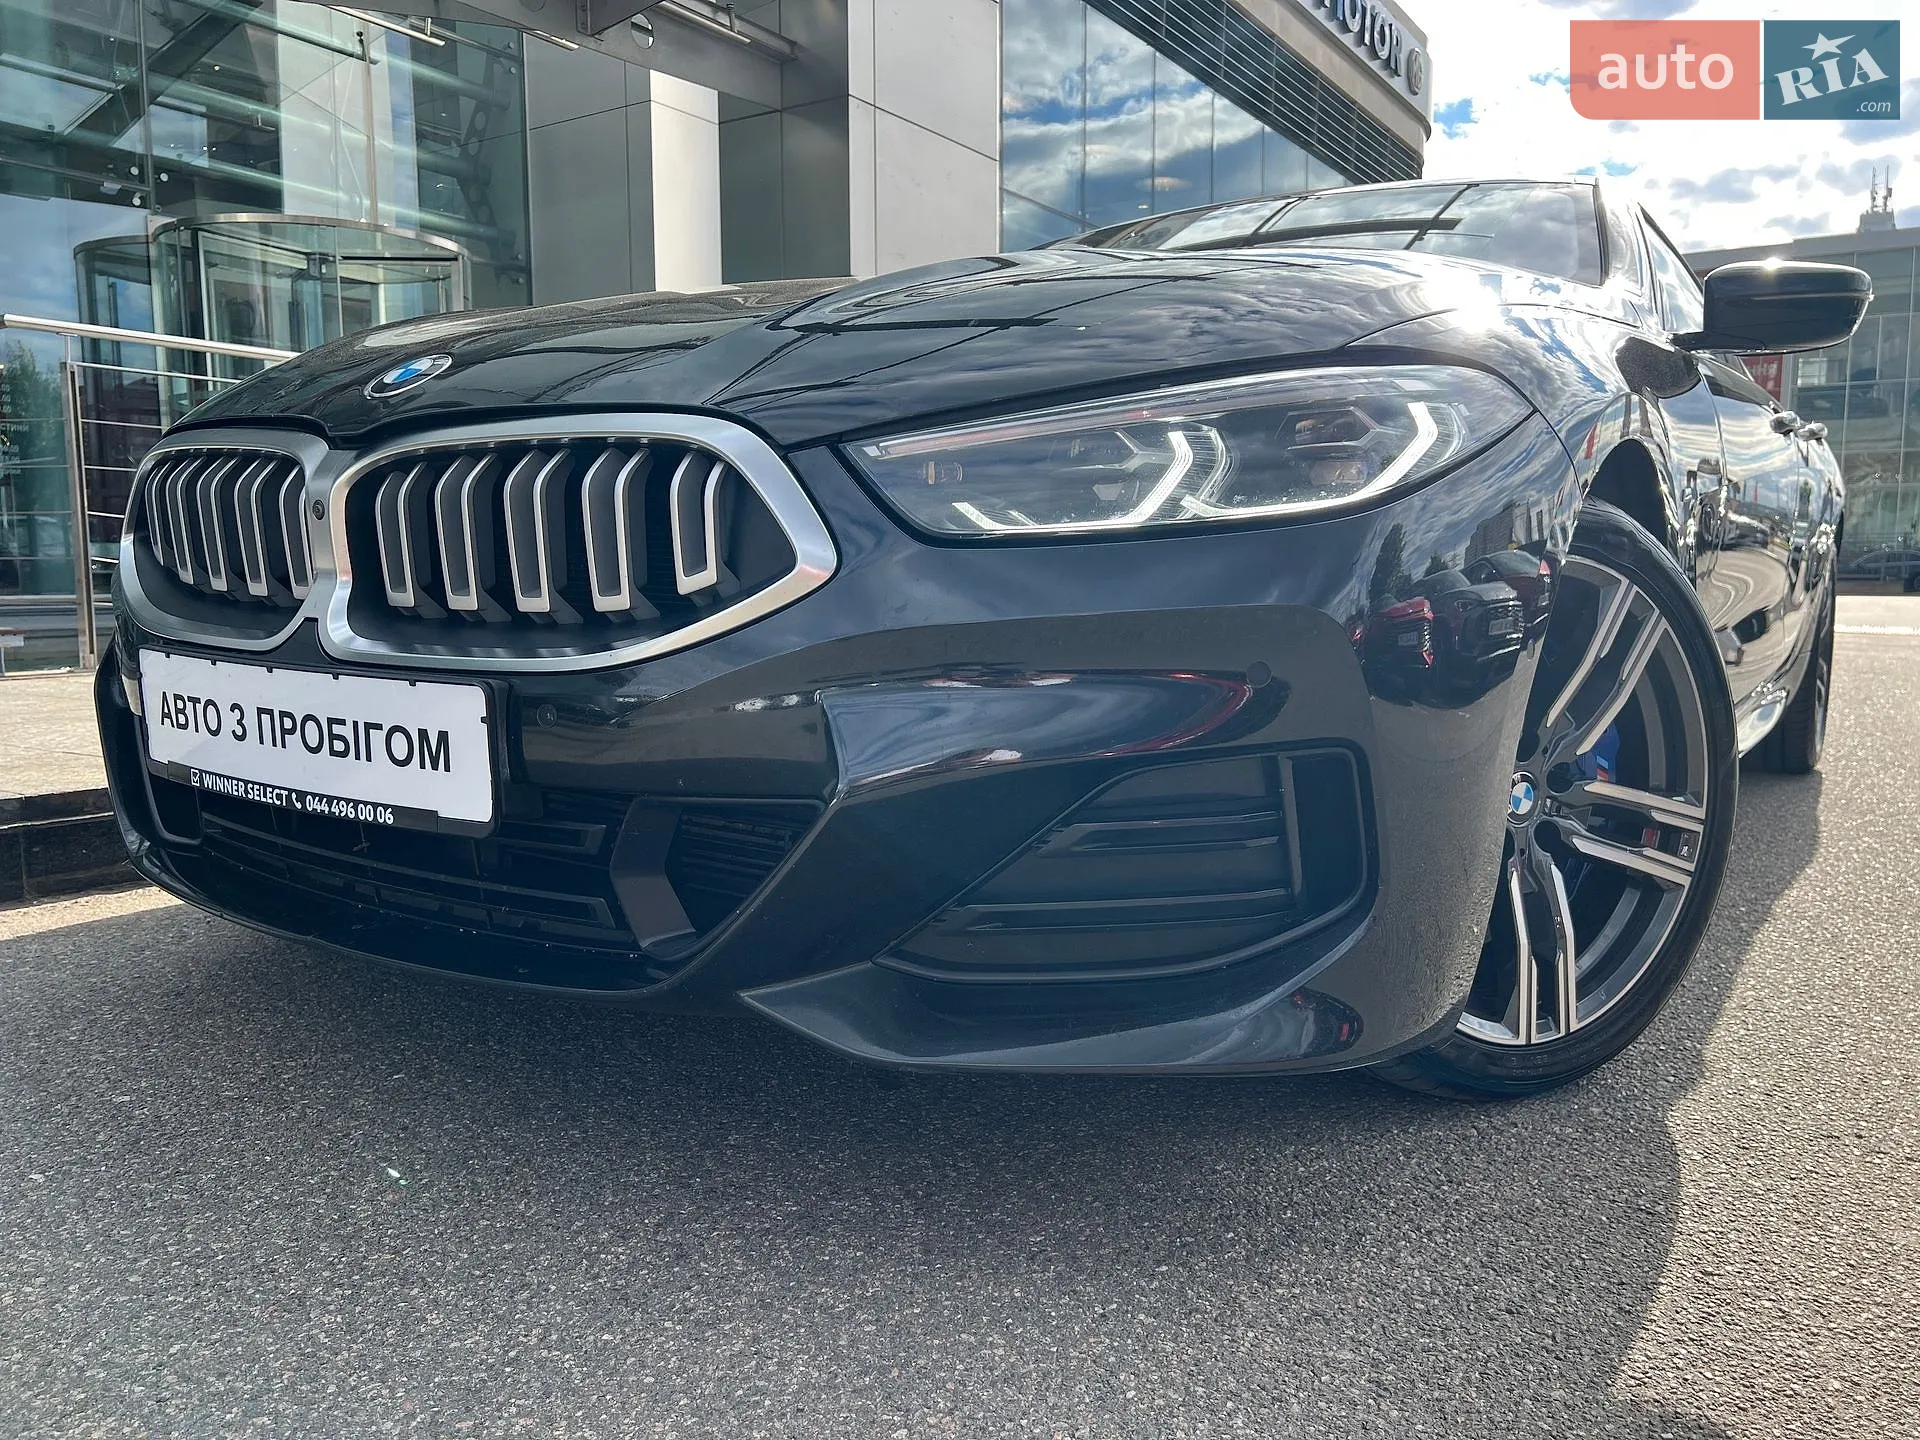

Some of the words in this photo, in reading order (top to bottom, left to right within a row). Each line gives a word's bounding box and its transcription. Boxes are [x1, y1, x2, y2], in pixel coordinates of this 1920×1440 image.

[160, 690, 222, 738] АВТО
[256, 706, 452, 773] ПРОБІГОМ
[202, 772, 246, 798] WINNER
[247, 783, 289, 807] SELECT
[305, 794, 330, 815] 044
[330, 799, 356, 819] 496
[357, 803, 375, 822] 00
[376, 806, 394, 825] 06
